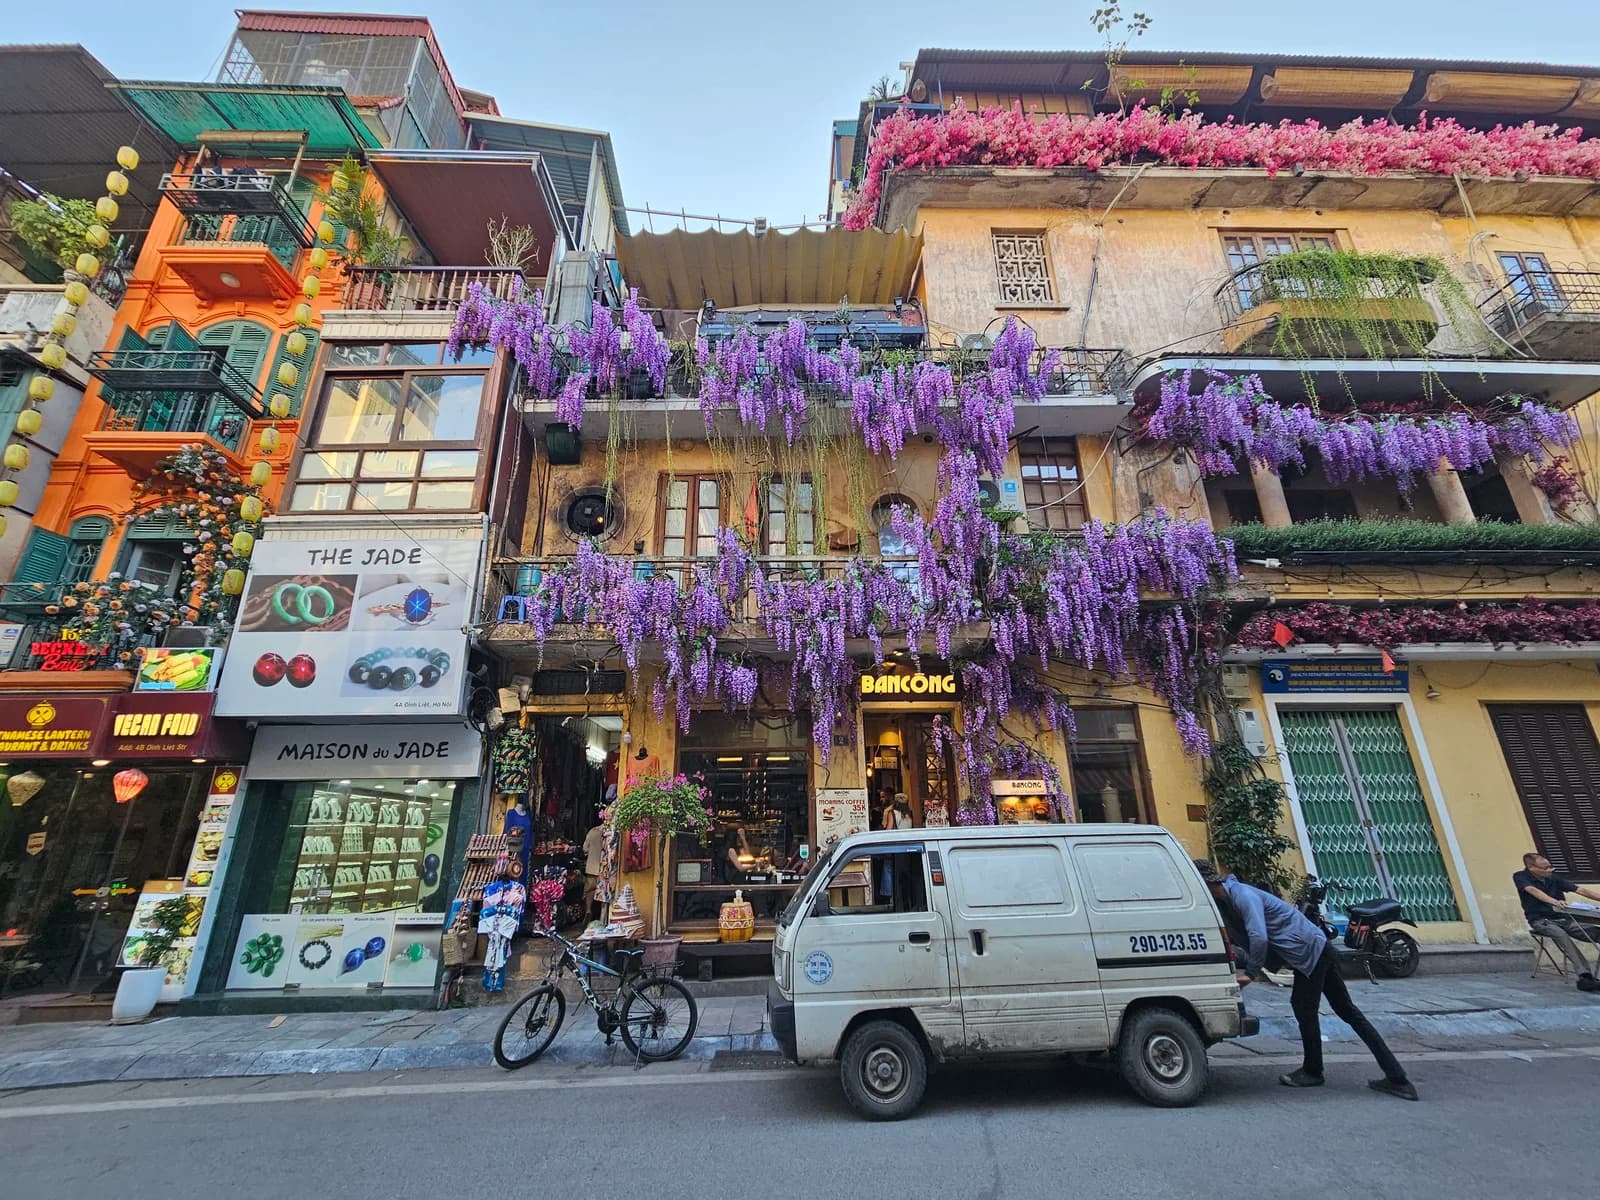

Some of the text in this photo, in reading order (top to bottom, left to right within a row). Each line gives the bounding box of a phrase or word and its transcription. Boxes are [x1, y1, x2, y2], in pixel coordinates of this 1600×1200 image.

[307, 547, 422, 566] THE JADE
[113, 713, 199, 736] VEGAN FOOD
[44, 730, 91, 740] LANTERN
[39, 741, 49, 751] &
[50, 741, 90, 751] DRINKS
[277, 741, 449, 761] MAISON du JADE
[852, 804, 866, 812] 35K
[1129, 933, 1208, 953] 29D-123.55
